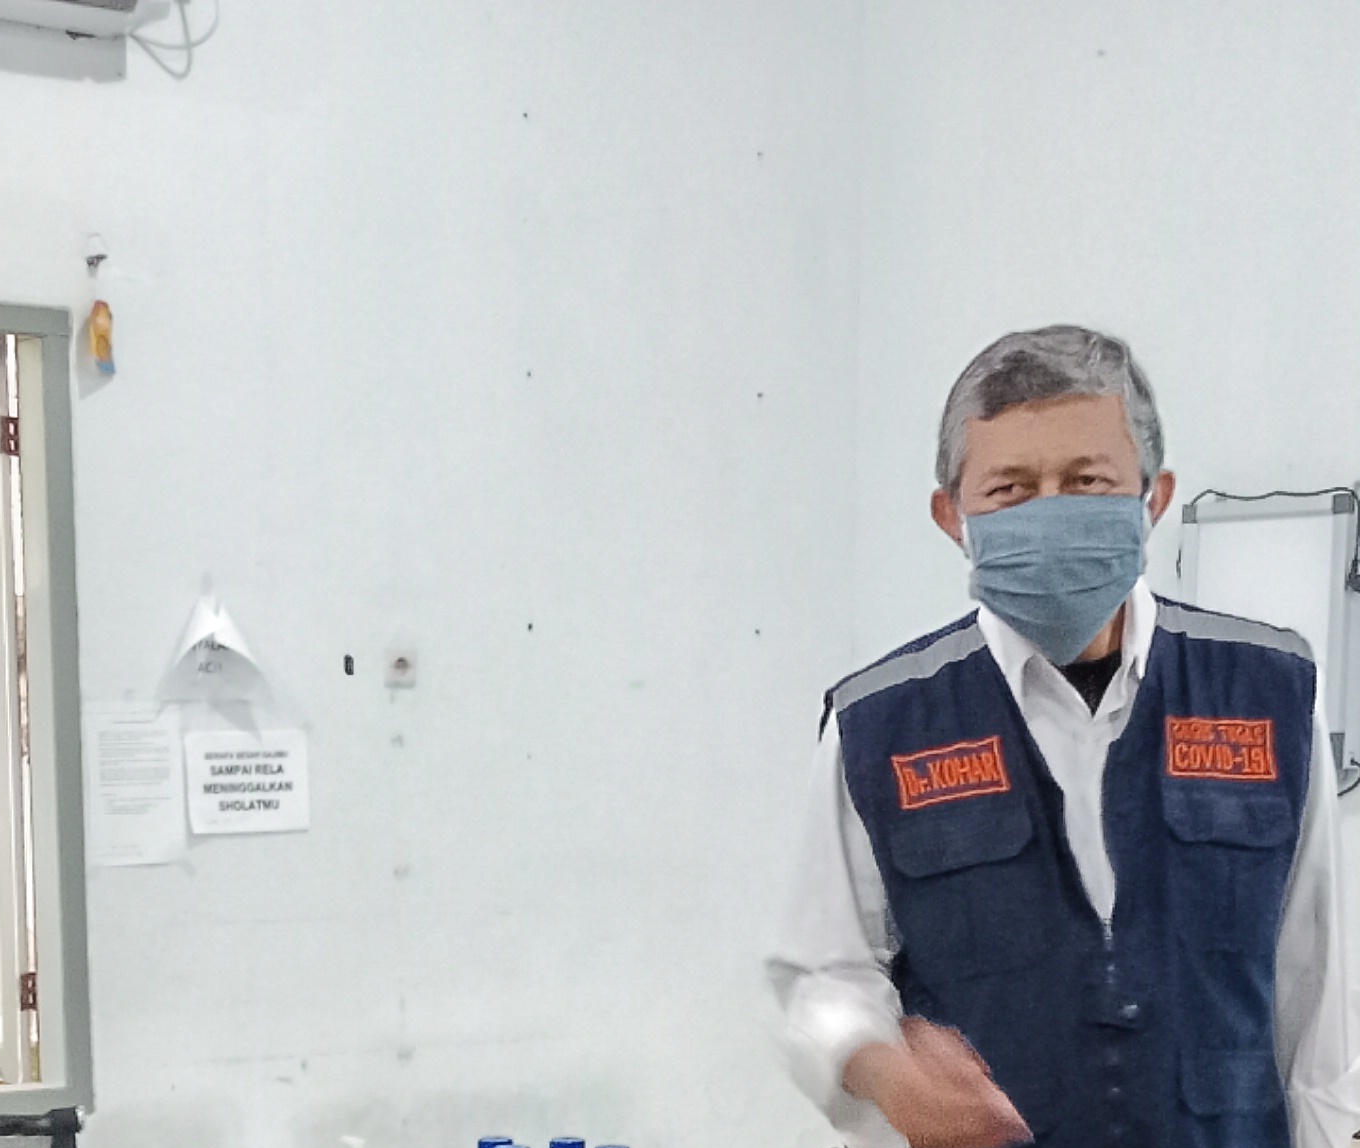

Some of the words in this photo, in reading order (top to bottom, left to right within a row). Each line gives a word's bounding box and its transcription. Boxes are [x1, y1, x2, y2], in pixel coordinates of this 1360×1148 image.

[1174, 742, 1266, 774] COVID-19
[209, 764, 253, 776] SAMPAI
[255, 763, 284, 775] RELA
[203, 781, 294, 795] MENINGGALKAN
[218, 798, 280, 812] SHOLATMU
